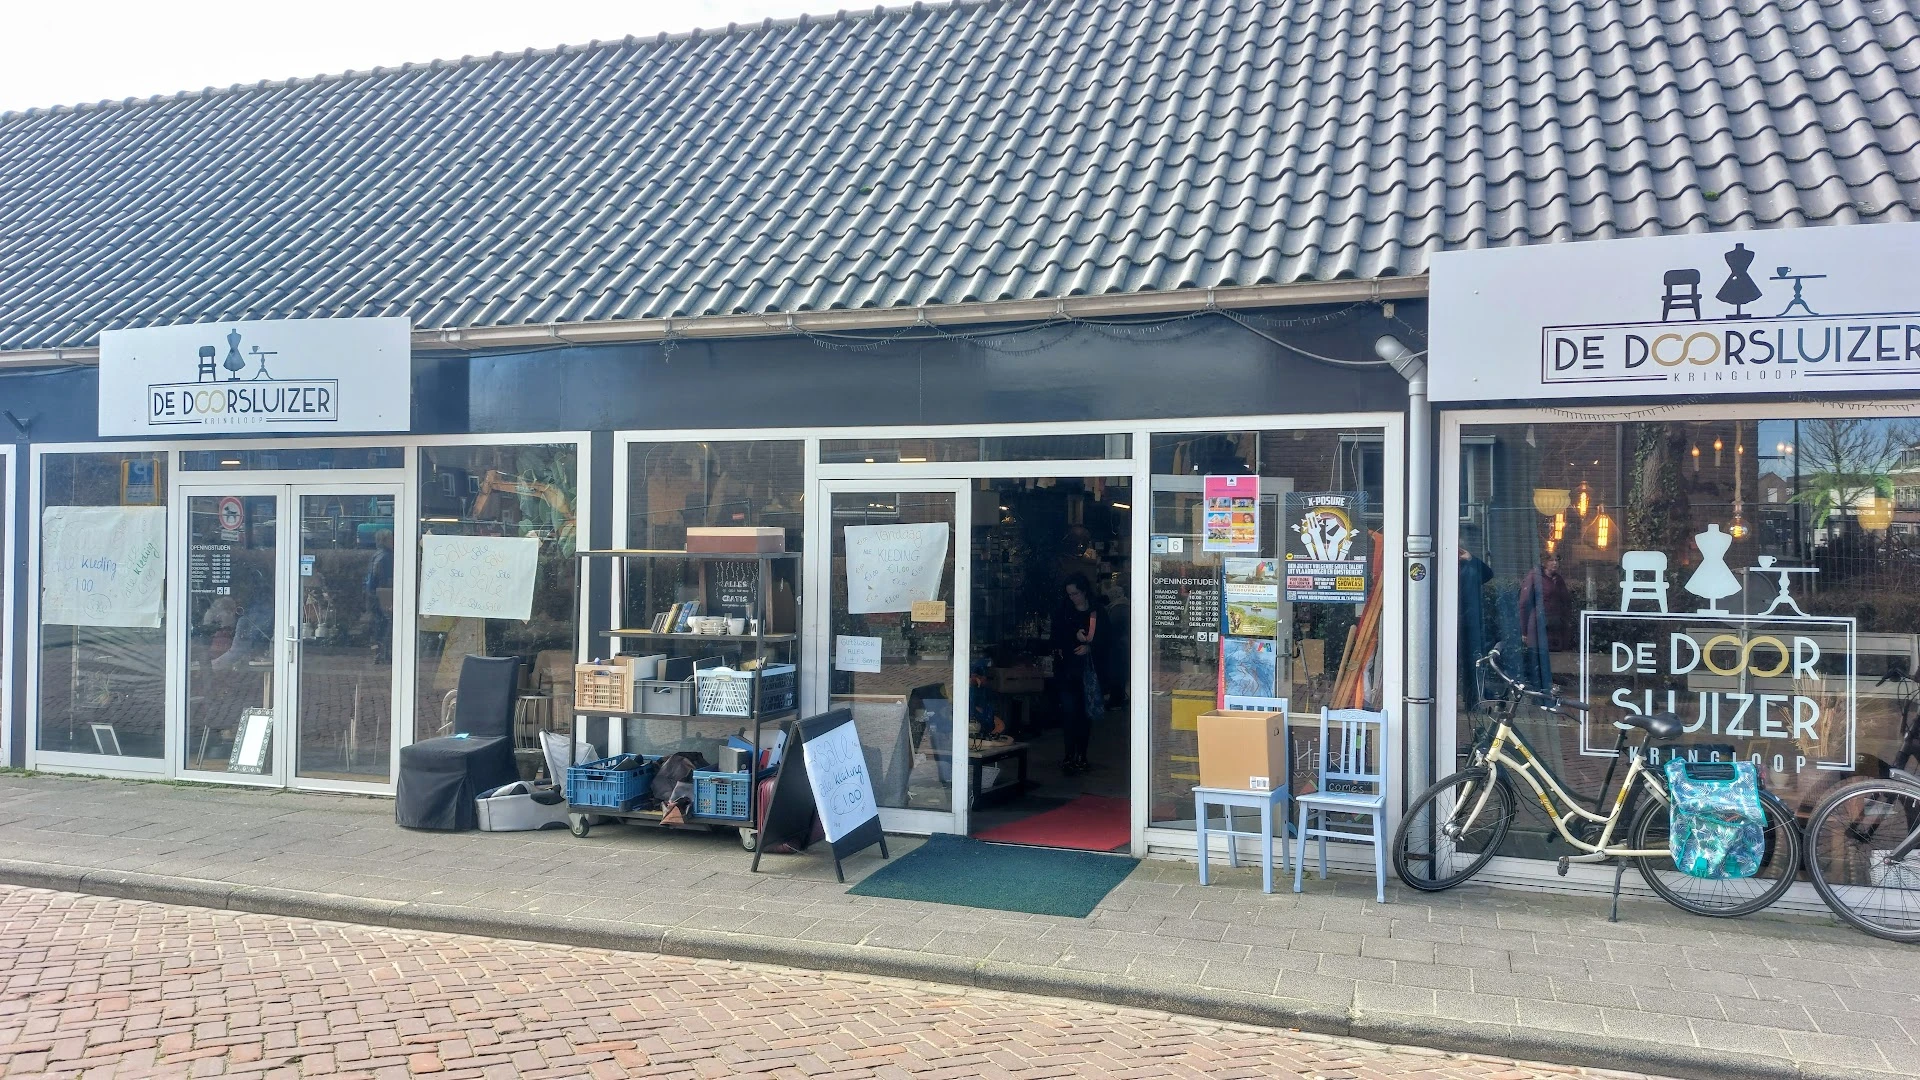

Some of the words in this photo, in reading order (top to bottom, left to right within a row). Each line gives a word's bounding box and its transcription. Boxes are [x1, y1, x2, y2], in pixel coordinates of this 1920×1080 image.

[1555, 336, 1604, 370] DE
[1625, 324, 1920, 368] DOORSLUIZER
[1673, 369, 1797, 383] KRINGLOOP
[154, 391, 175, 416] DE
[183, 387, 330, 415] DOORSLUIZER
[1307, 496, 1346, 507] X-POSURE
[1172, 540, 1179, 551] 6
[877, 548, 920, 562] KLEDING
[81, 555, 117, 581] kleding
[1153, 578, 1219, 586] OPENINGSTIJDEN
[1611, 642, 1657, 674] DE
[1669, 632, 1821, 681] DOOR
[1328, 782, 1364, 794] comes
